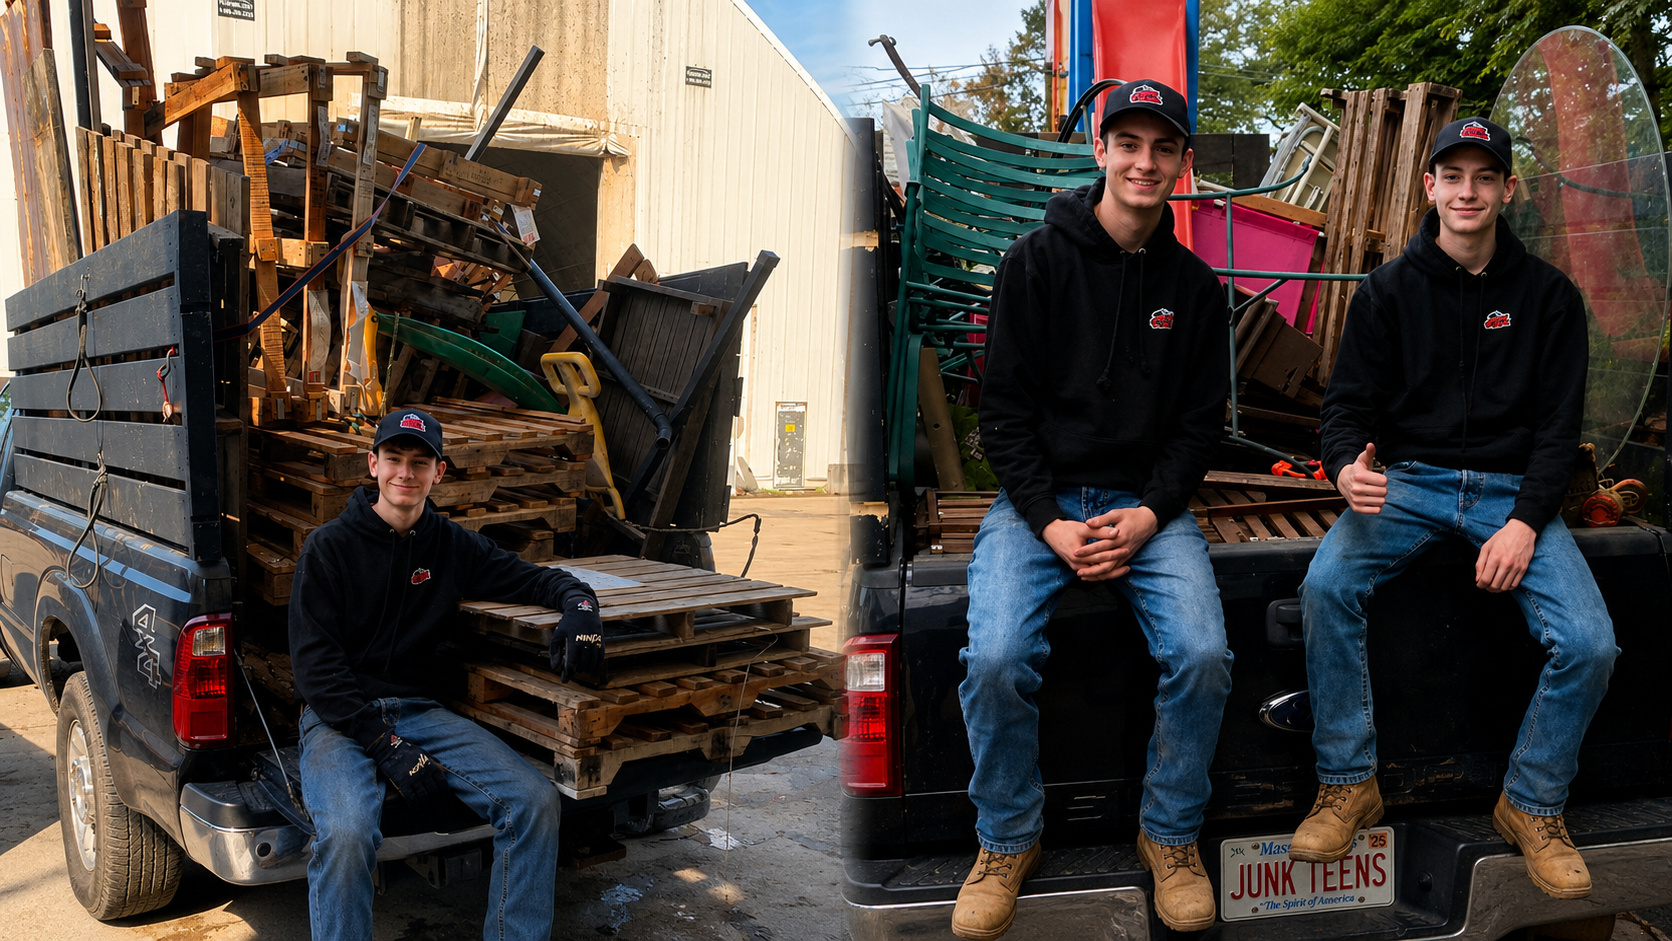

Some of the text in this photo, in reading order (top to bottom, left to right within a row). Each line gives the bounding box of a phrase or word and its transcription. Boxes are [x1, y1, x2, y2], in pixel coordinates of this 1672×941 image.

[1371, 835, 1386, 848] 25
[1230, 860, 1296, 900] JUNK
[1310, 852, 1387, 893] TEENS
[1282, 898, 1307, 910] Spirit
[1307, 896, 1318, 909] of
